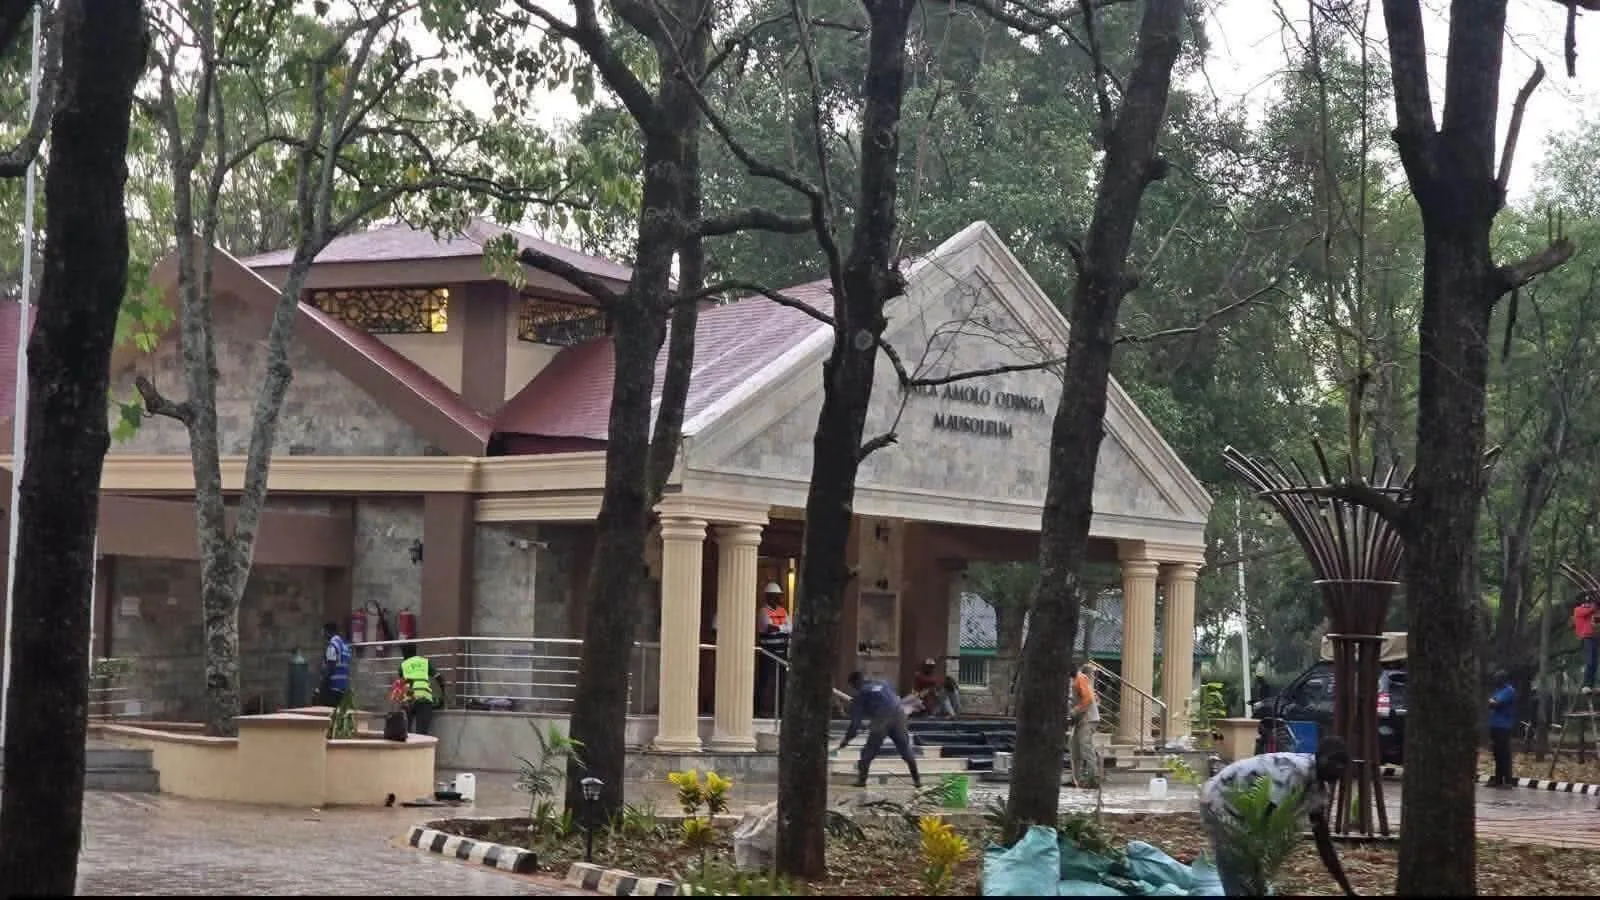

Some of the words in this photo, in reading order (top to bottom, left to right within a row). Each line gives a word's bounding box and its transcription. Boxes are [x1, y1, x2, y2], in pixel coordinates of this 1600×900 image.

[942, 384, 991, 406] AMOLO
[995, 391, 1046, 414] ODINGA
[933, 413, 1013, 438] MAUSOLEUM
